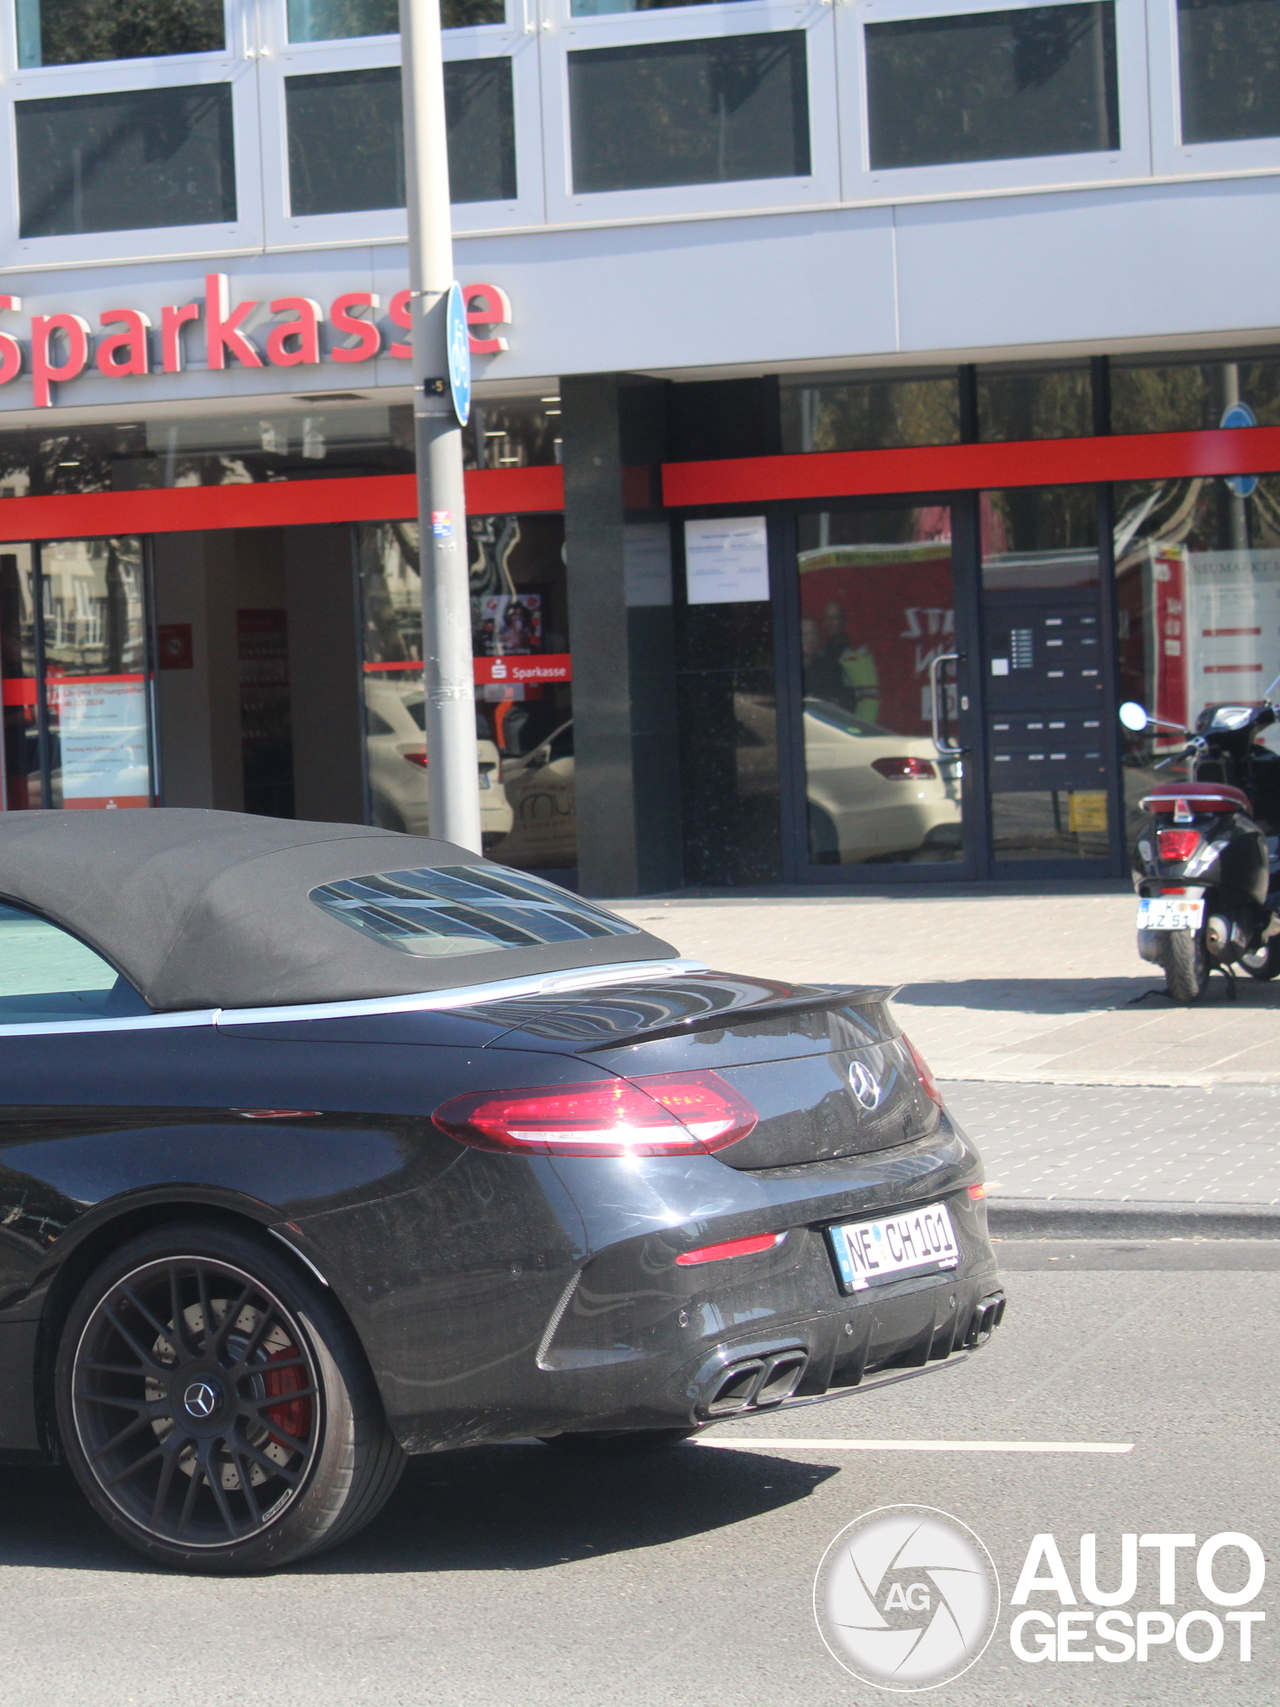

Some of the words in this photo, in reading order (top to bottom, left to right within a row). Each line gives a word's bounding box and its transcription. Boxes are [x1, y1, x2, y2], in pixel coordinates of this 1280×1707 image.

[512, 666, 567, 681] Sparkasse
[1165, 900, 1175, 913] K
[1147, 915, 1166, 928] LZ
[1172, 915, 1189, 928] 51
[846, 1229, 880, 1272] NE
[914, 1212, 954, 1256] 101
